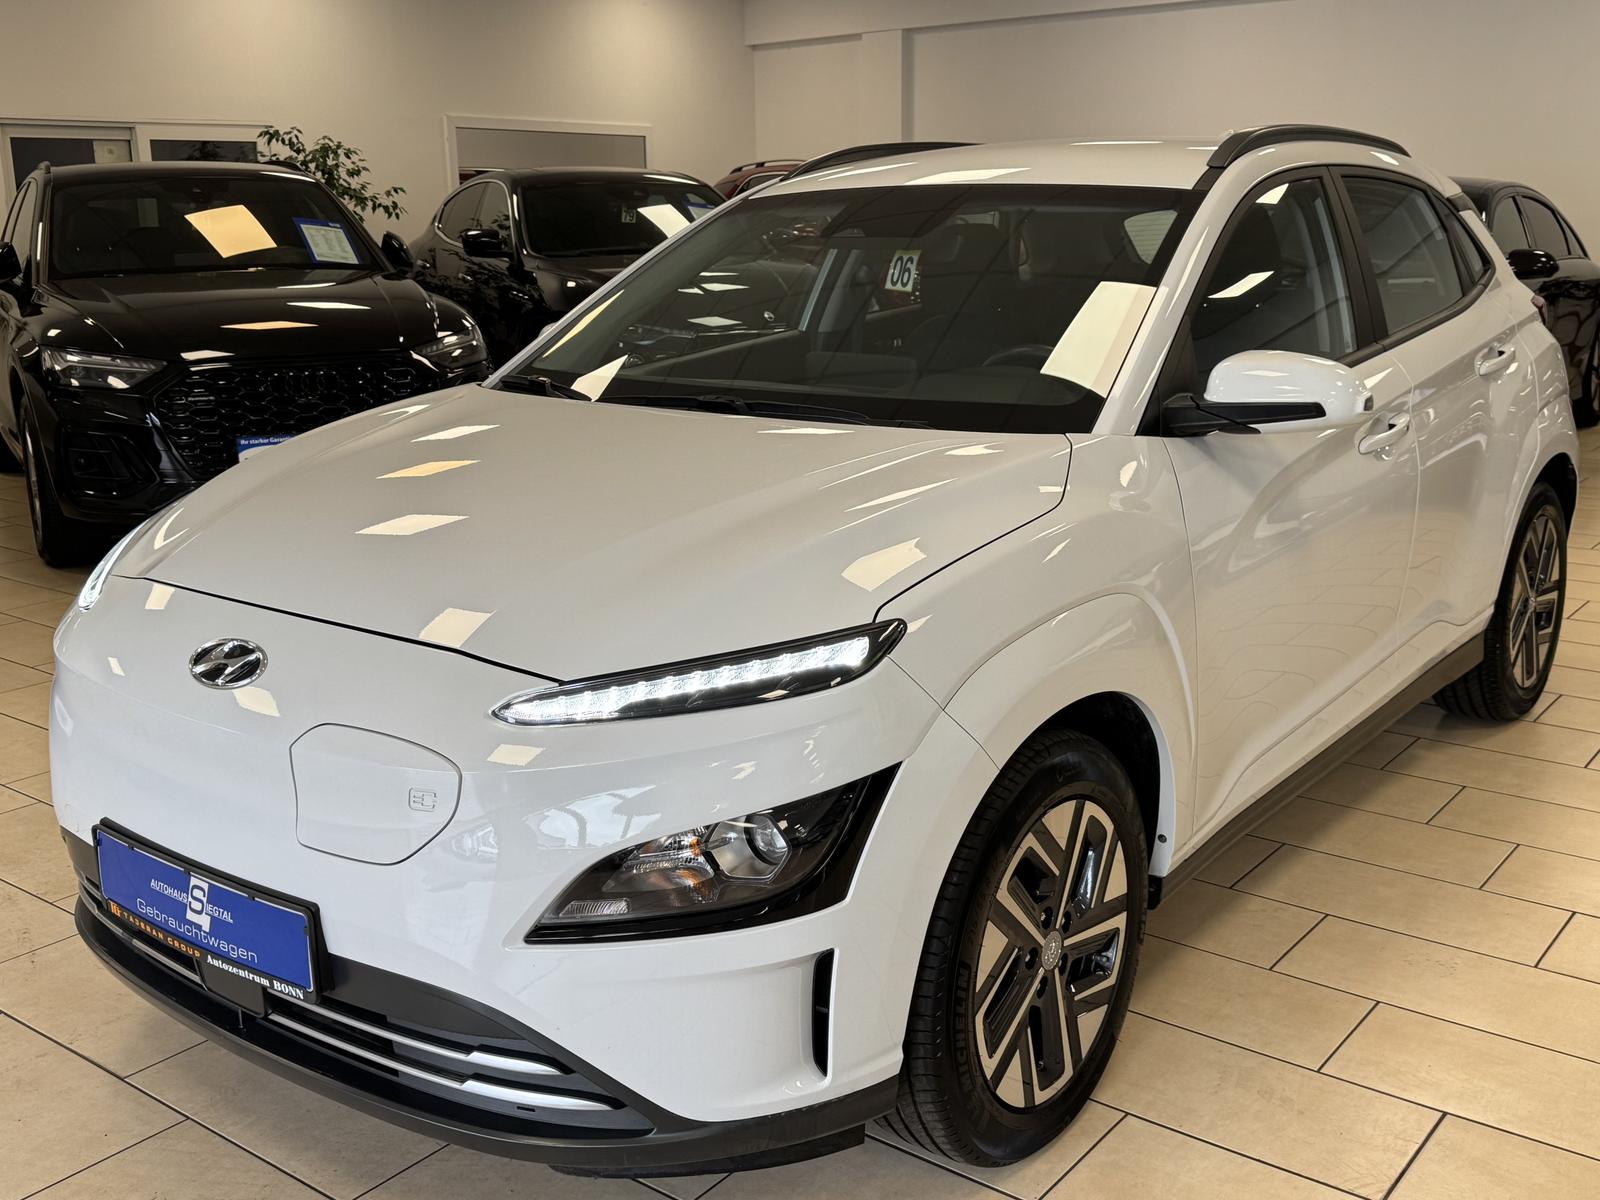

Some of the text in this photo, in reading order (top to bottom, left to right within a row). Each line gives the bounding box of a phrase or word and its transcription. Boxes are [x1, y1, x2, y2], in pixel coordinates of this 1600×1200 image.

[891, 255, 914, 288] 06
[150, 879, 188, 904] AUTOHAUS
[136, 897, 258, 963] Gebrauchtwagen
[167, 937, 200, 958] GROUP
[206, 954, 304, 1000] Autozentrum BONN
[952, 966, 971, 1092] MICHELIN
